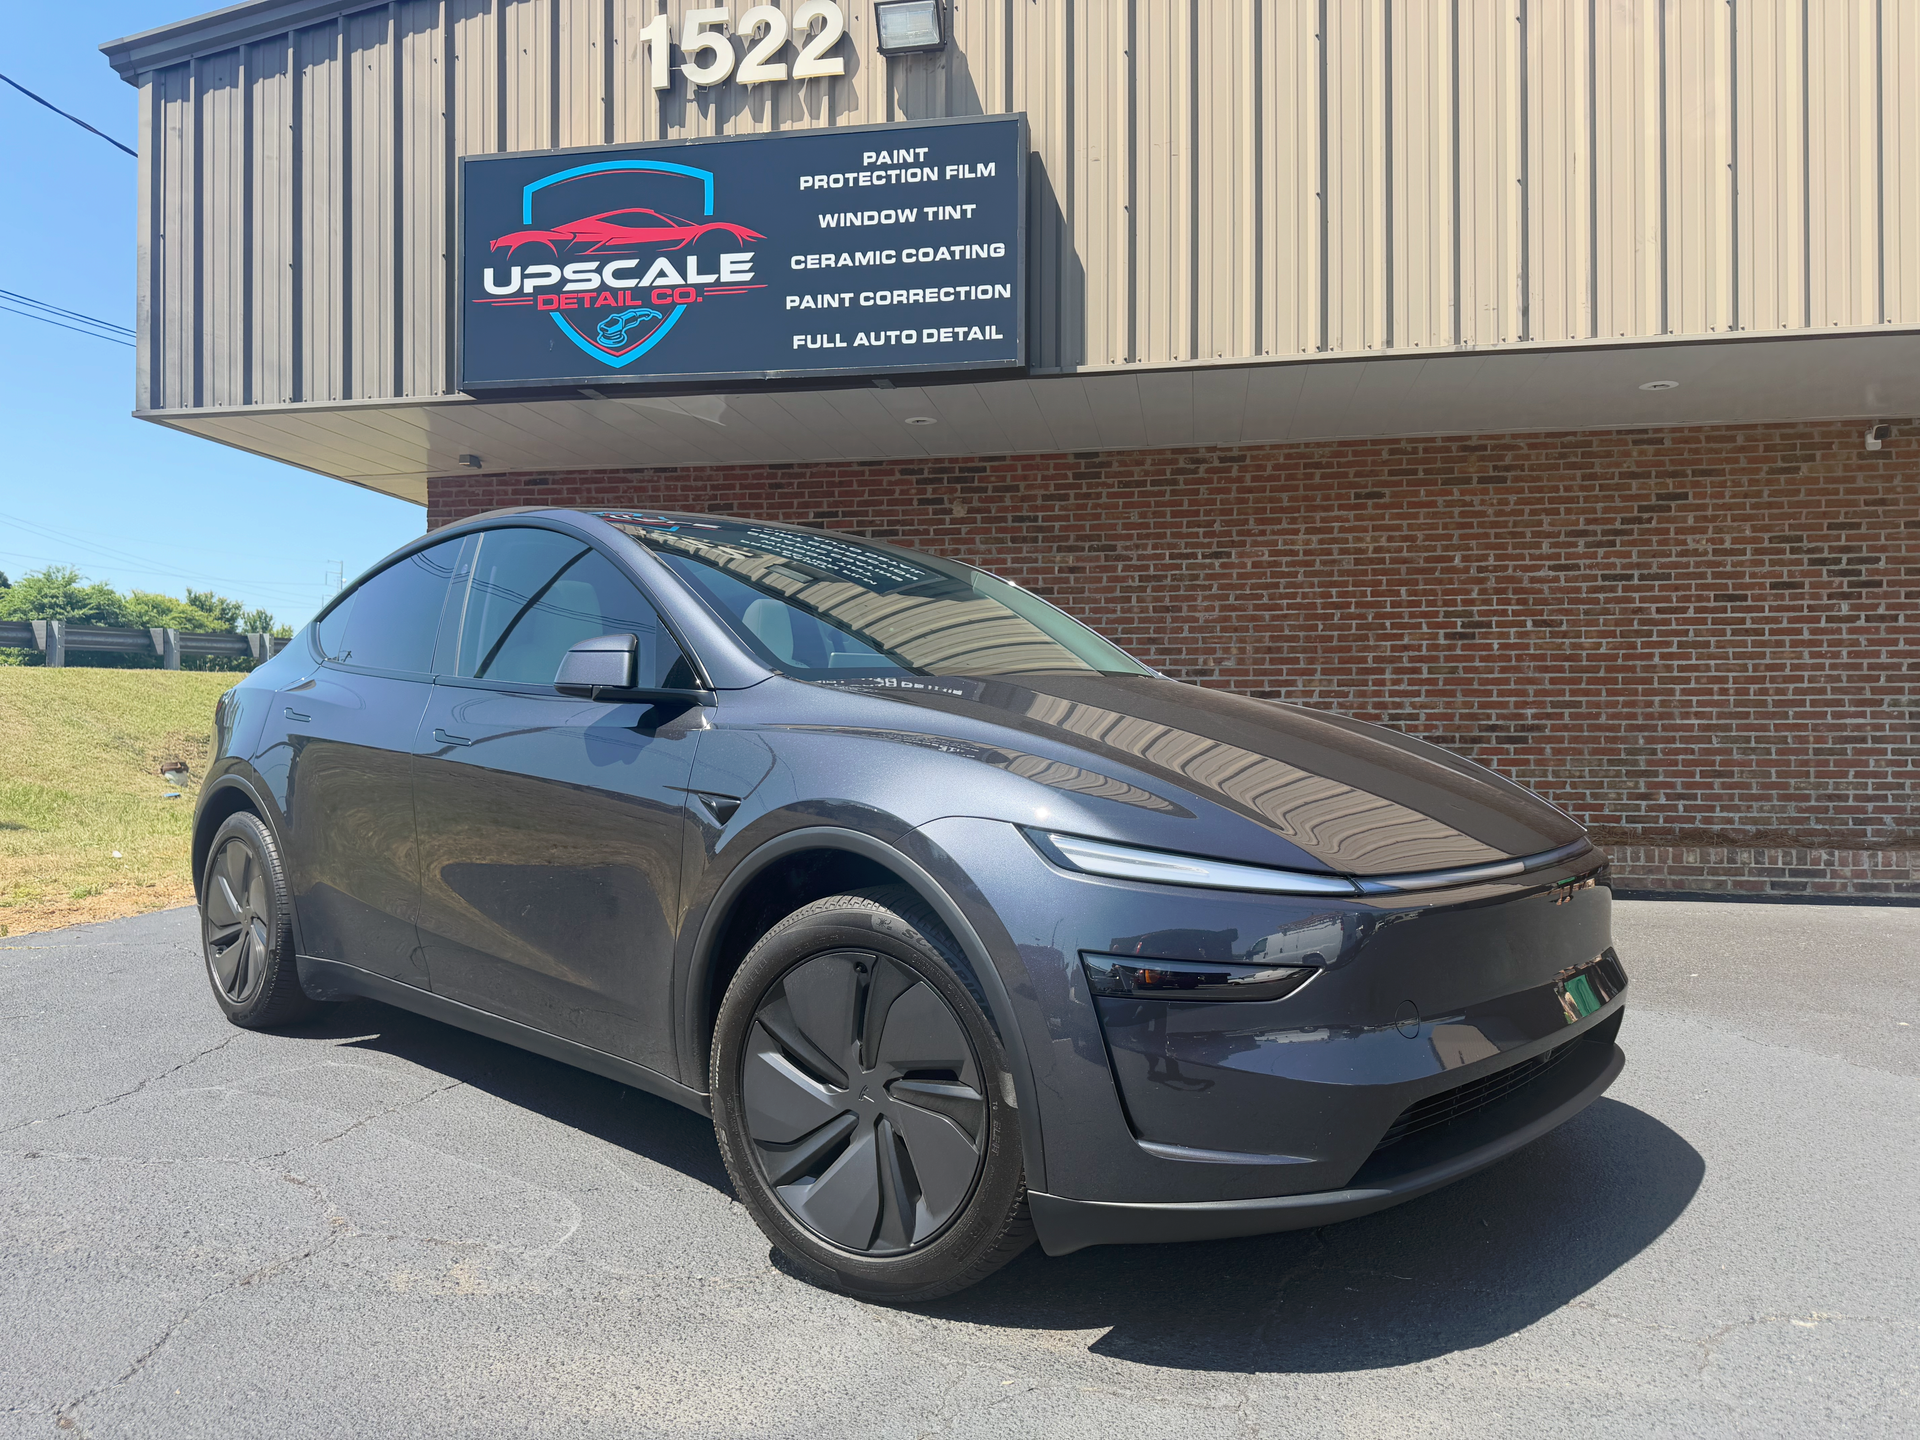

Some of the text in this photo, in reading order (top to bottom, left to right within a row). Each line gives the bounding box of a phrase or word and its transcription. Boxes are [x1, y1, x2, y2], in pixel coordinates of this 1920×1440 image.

[640, 0, 845, 90] 1522
[863, 147, 929, 166] PAINT
[799, 162, 996, 191] PROTECTION FILM
[818, 203, 977, 229] WINDOW TINT
[790, 242, 1006, 270] CERAMIC COATING
[483, 251, 755, 296] UPSCALE
[537, 286, 703, 311] DETAIL CO.
[786, 283, 1011, 310] PAINT CORRECTION
[793, 325, 1004, 350] FULL AUTO DETAIL
